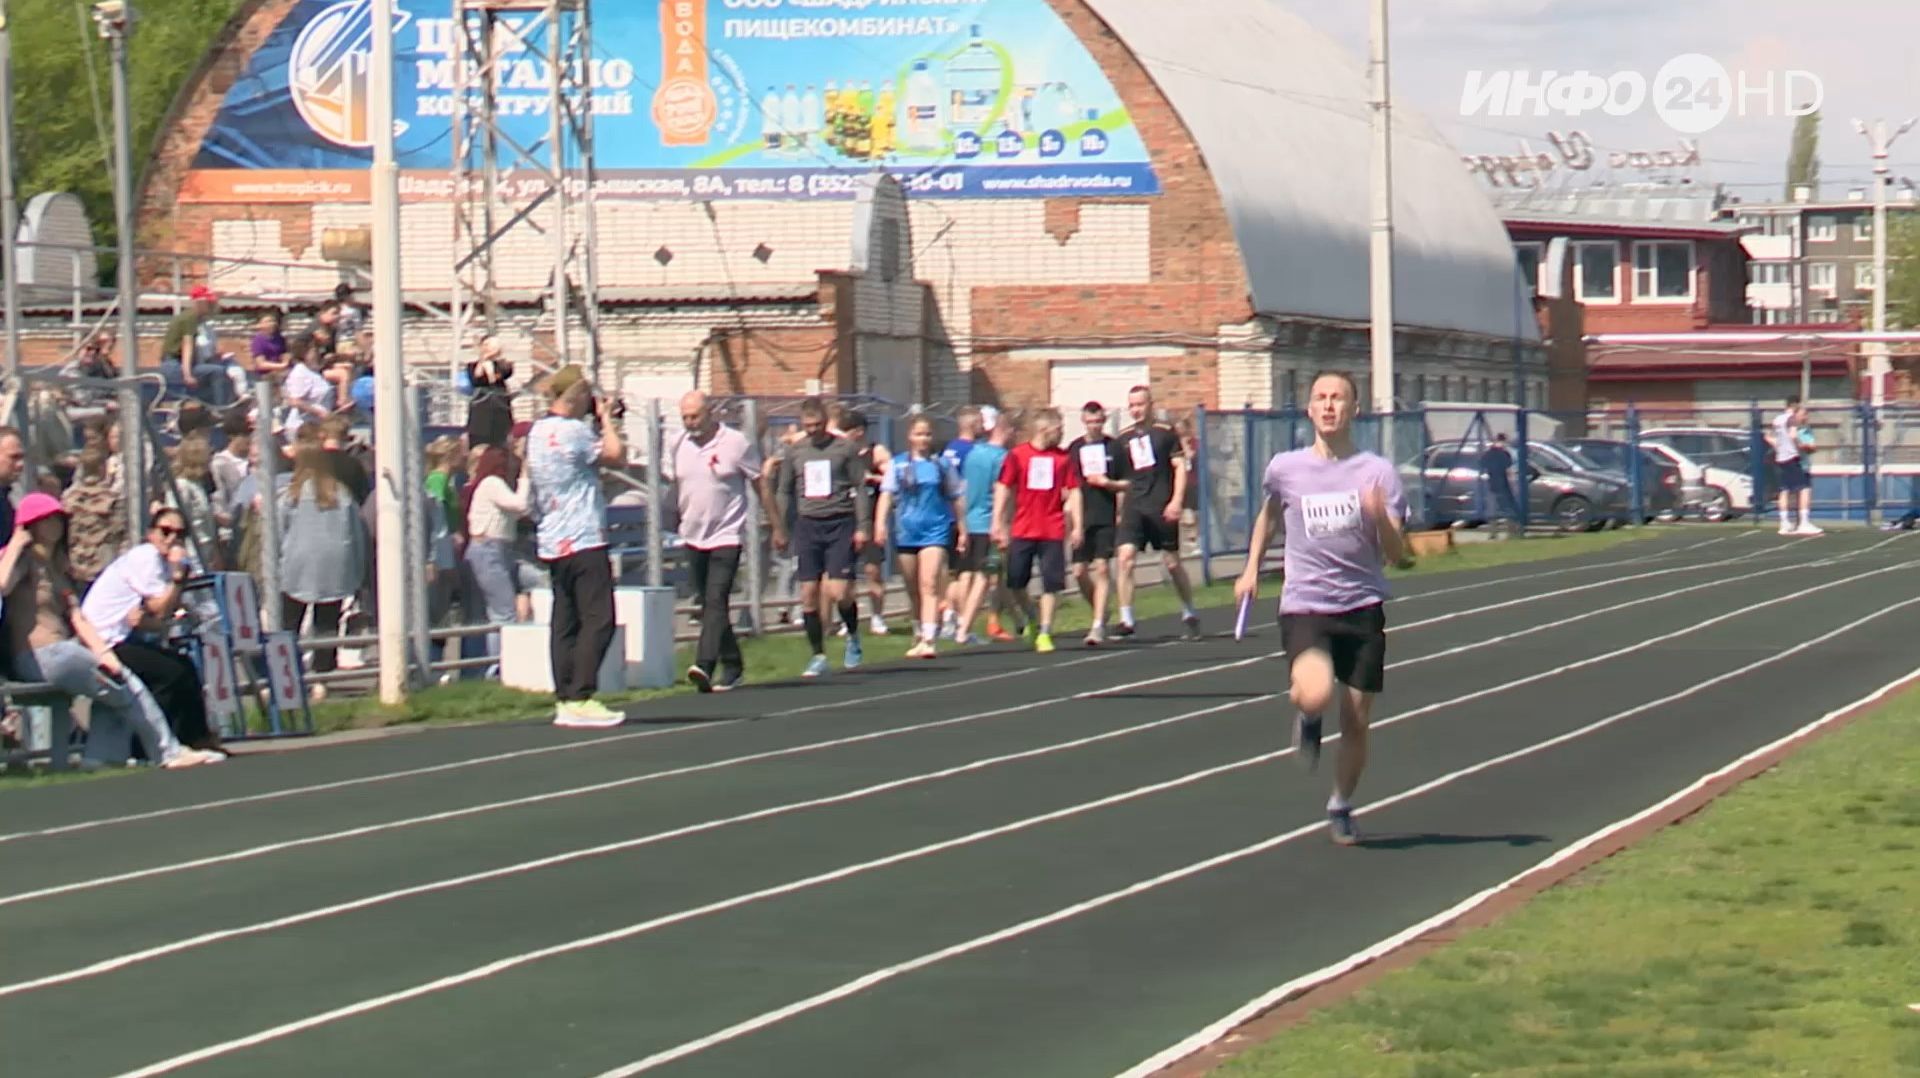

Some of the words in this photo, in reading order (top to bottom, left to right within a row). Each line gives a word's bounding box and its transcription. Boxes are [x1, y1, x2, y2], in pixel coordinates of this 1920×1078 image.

[724, 17, 960, 41] ПИЩЕКОМБИНАТ»
[788, 175, 805, 193] 8
[235, 584, 253, 639] 1
[207, 643, 229, 700] 2
[276, 643, 295, 700] 3
